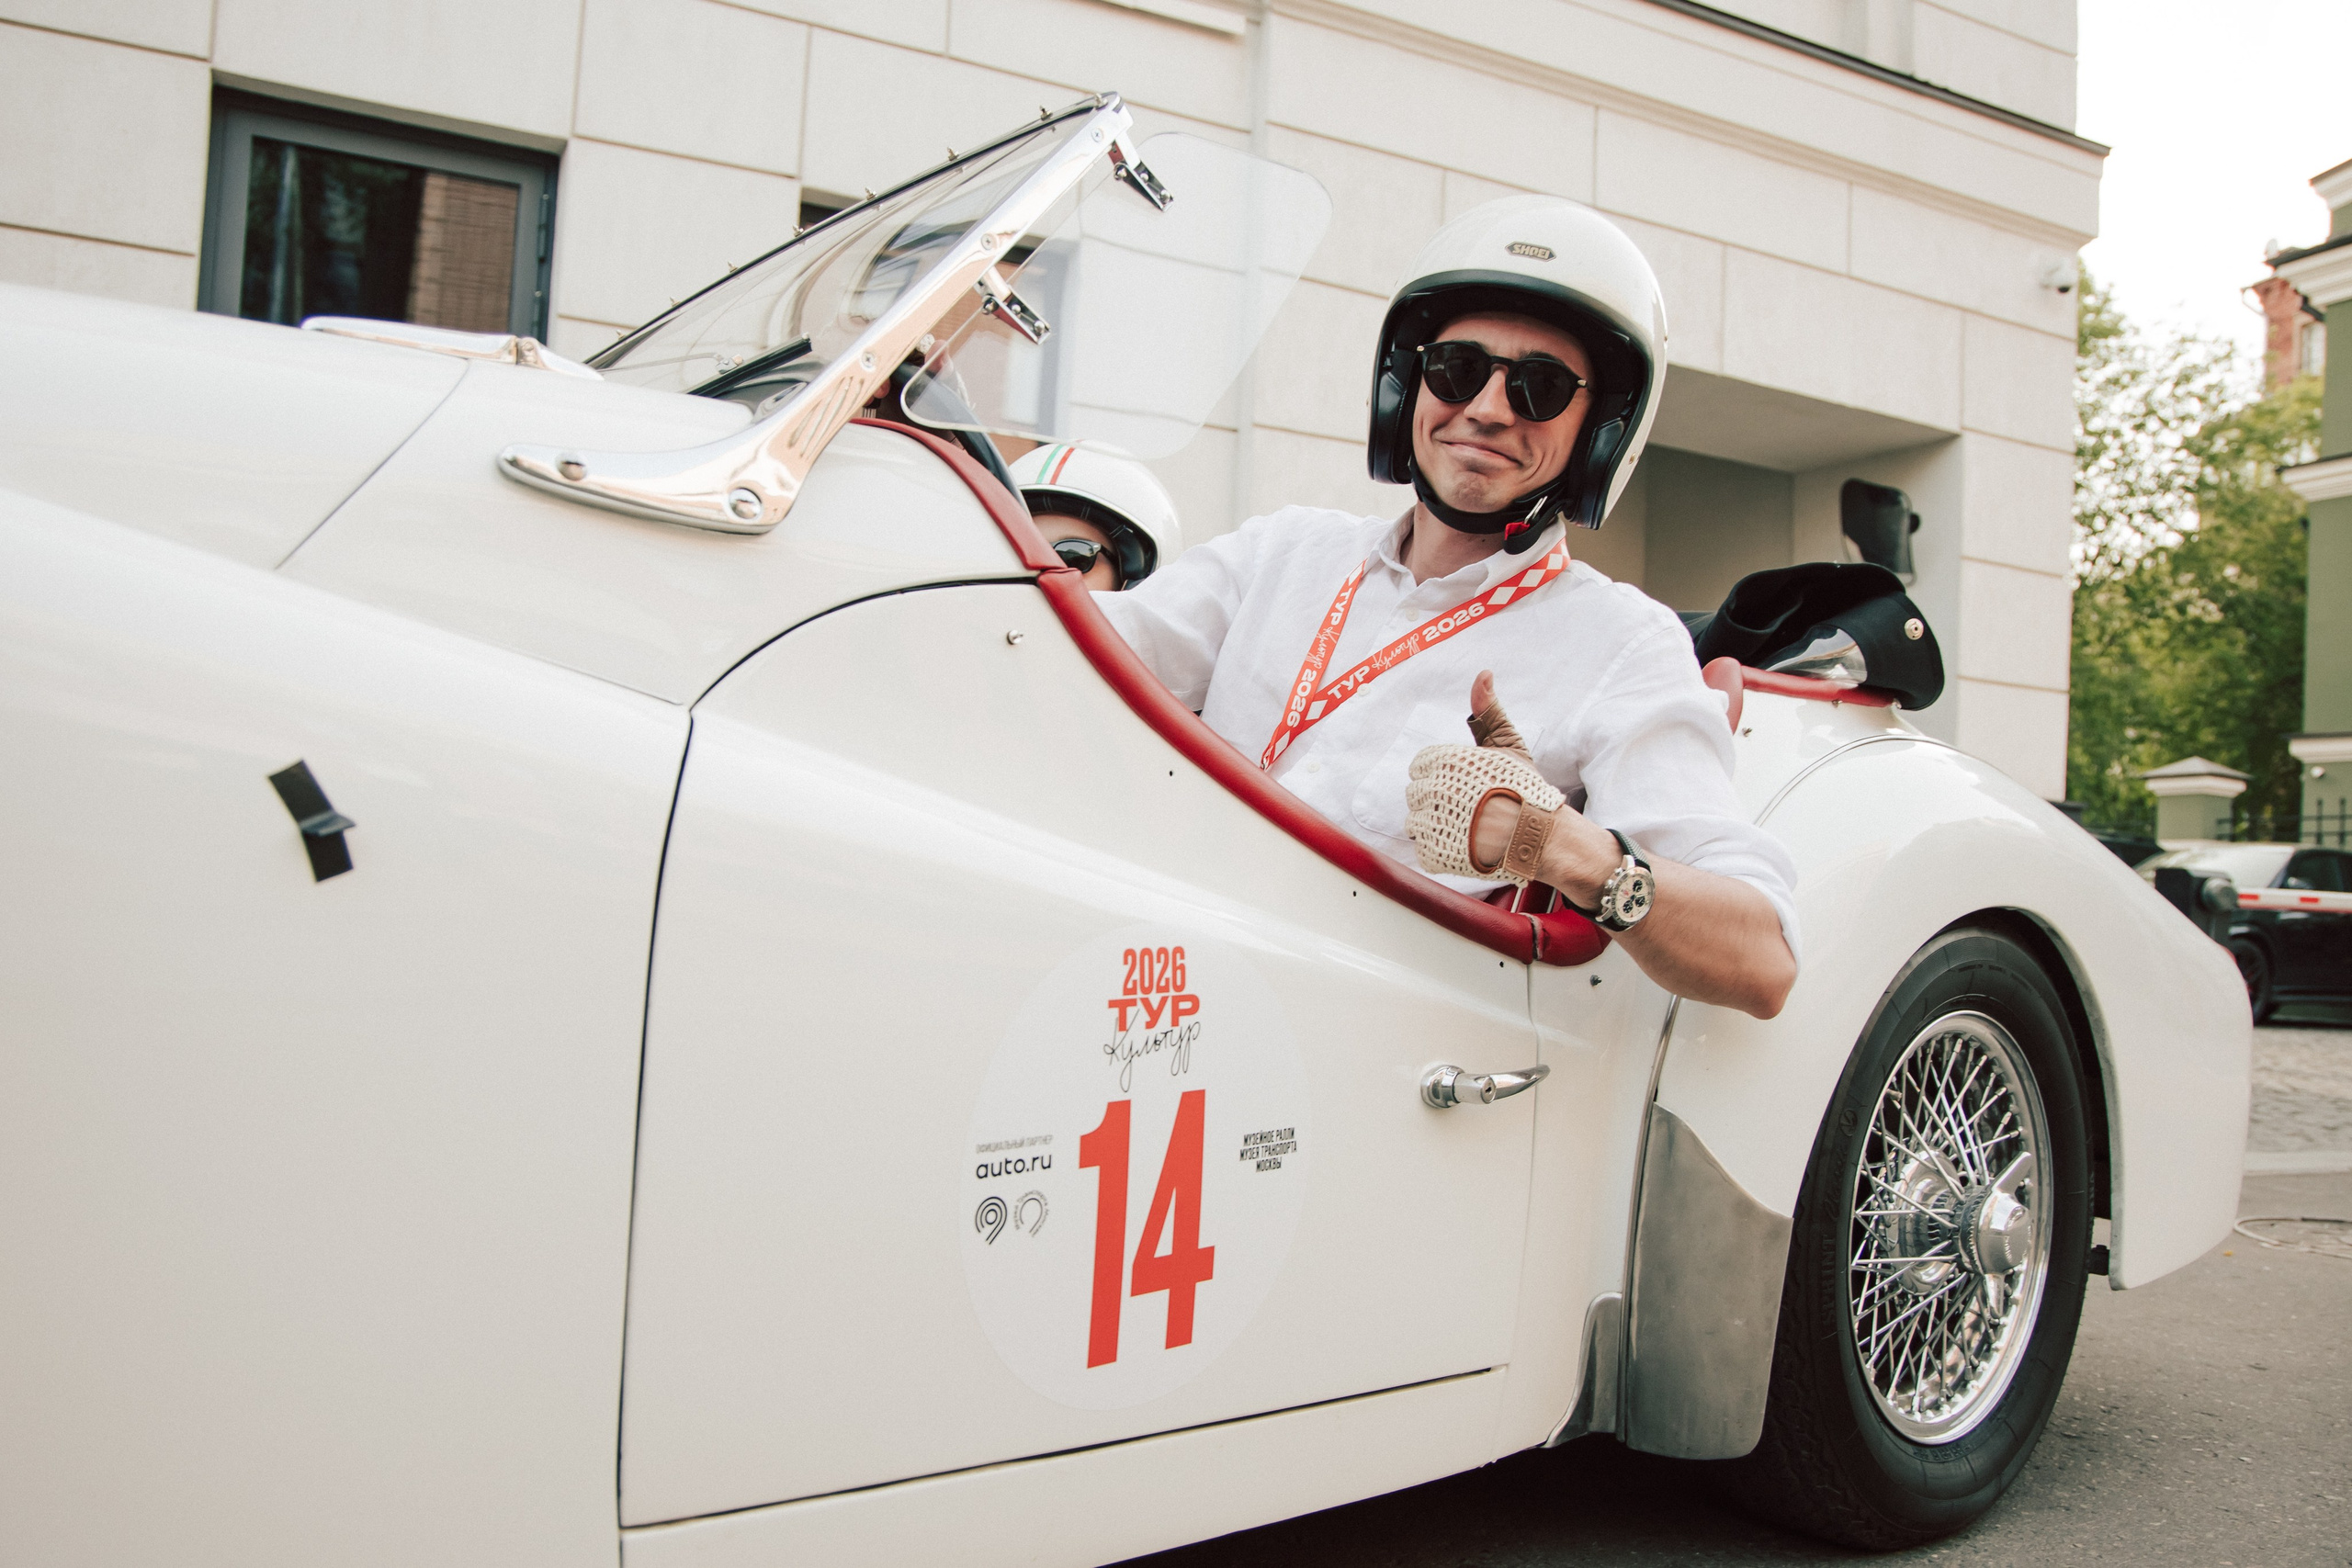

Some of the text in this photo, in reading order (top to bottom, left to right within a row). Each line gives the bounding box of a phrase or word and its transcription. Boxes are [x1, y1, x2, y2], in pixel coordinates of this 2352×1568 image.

[1512, 243, 1550, 259] SHOEI
[1330, 588, 1353, 626] ТУР
[1328, 664, 1371, 700] ТУР
[1422, 602, 1486, 642] 2026
[1287, 668, 1317, 728] 2026
[1123, 946, 1186, 996] 2026
[1108, 994, 1200, 1032] ТУР
[1103, 1009, 1201, 1092] Культур
[976, 1155, 1052, 1179] auto.ru
[1256, 1156, 1282, 1172] МОСКВЫ
[1079, 1089, 1216, 1370] 14
[1820, 1234, 1836, 1326] SPRINT
